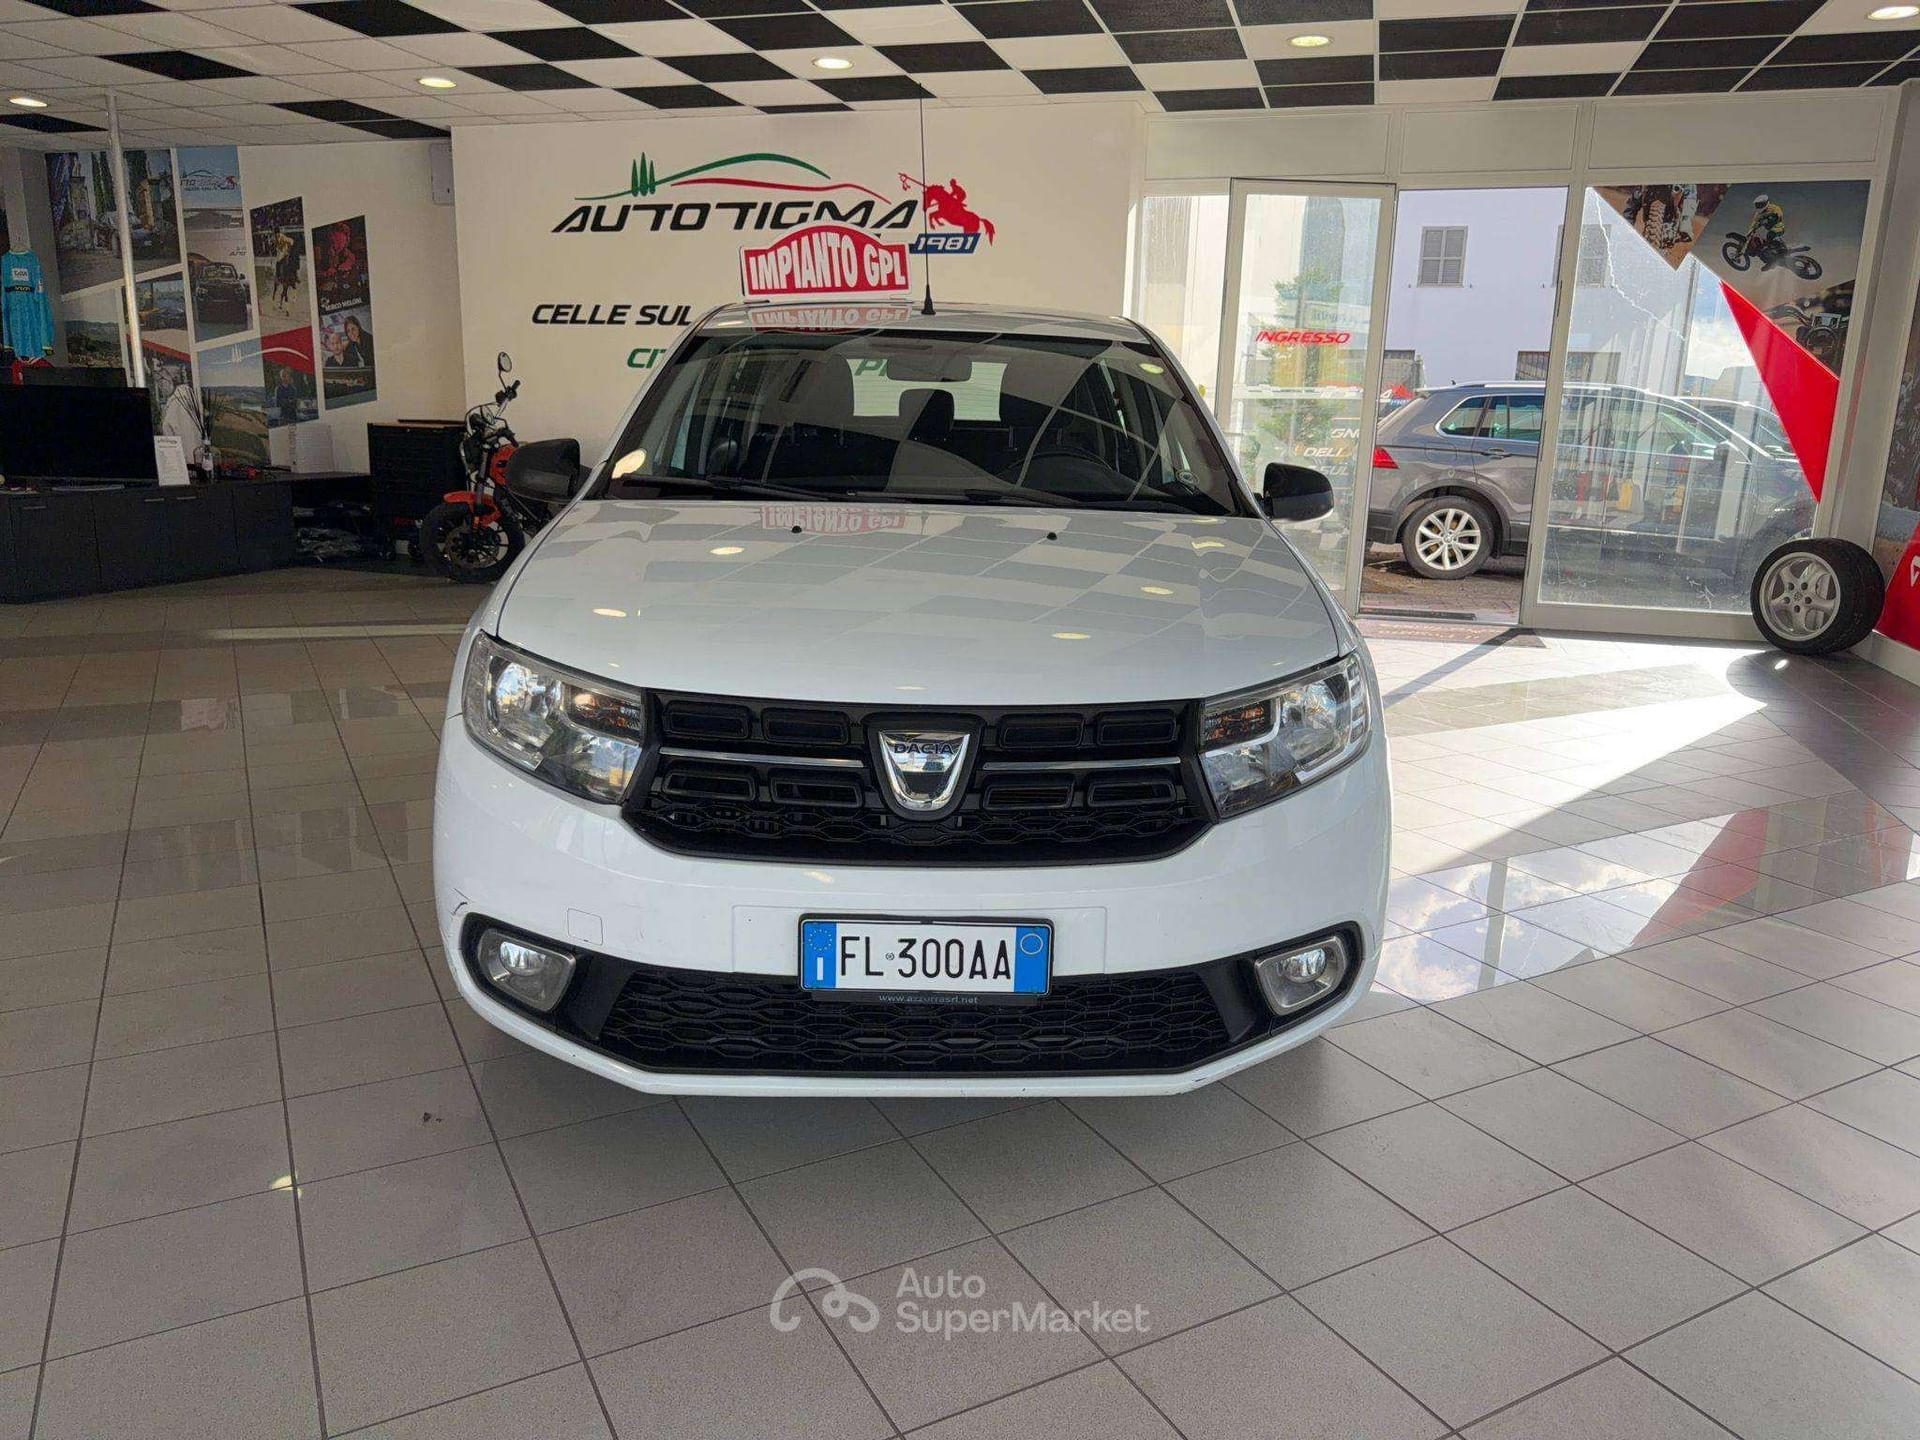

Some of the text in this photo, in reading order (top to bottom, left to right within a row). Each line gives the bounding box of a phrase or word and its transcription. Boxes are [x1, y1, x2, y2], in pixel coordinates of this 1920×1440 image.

[918, 236, 973, 251] 1981
[748, 231, 906, 290] IMPIANTO GPL
[532, 304, 691, 326] CELLE SUL
[1256, 330, 1350, 344] INGRESSO
[894, 743, 954, 755] DACIA
[897, 938, 1012, 980] 300AA
